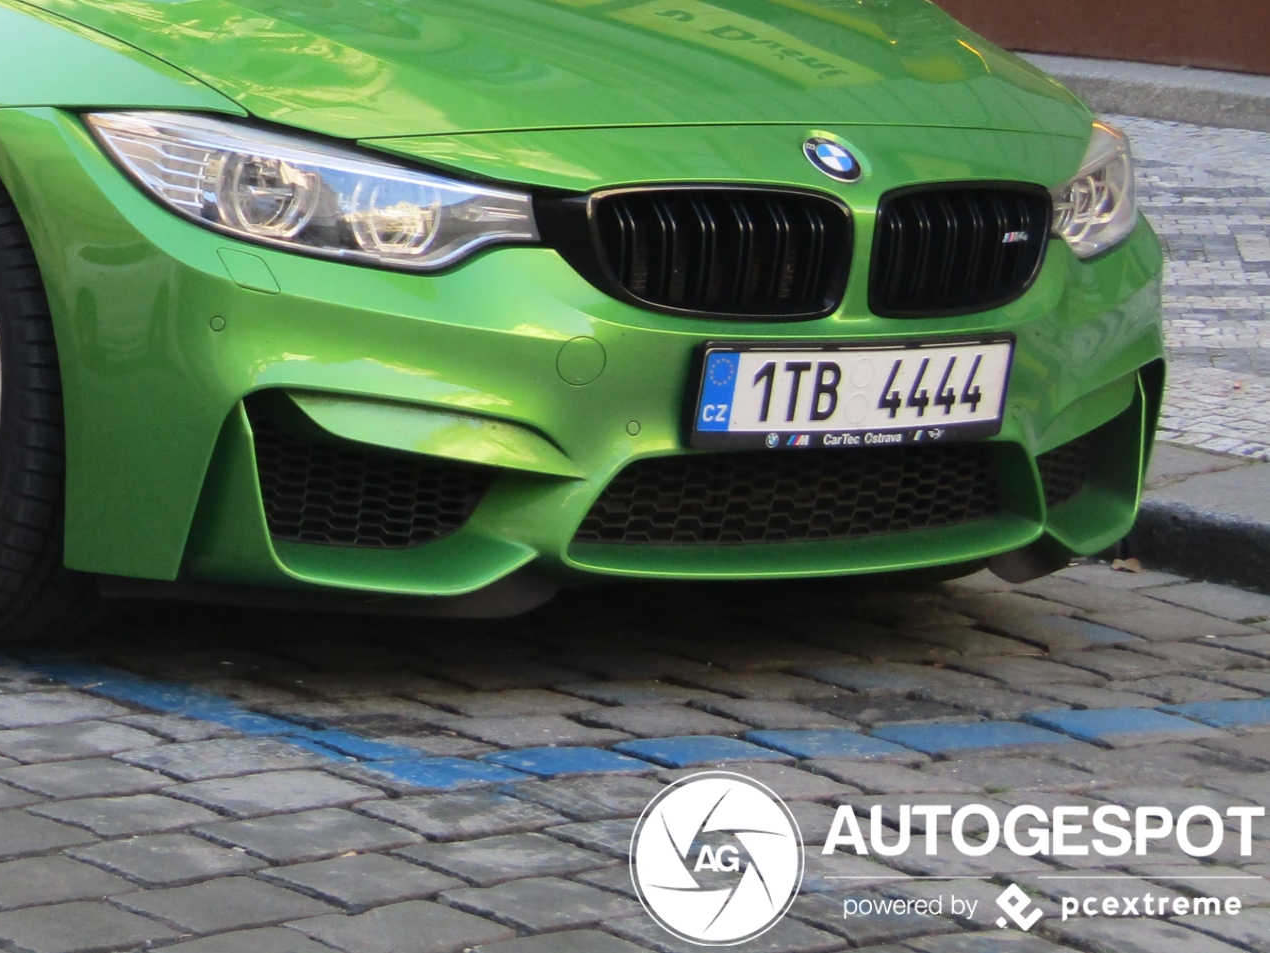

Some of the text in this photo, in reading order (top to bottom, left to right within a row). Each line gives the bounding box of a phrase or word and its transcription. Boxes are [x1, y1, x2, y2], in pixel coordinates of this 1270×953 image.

[752, 354, 983, 422] 1TB 4444
[702, 404, 728, 422] CZ
[823, 433, 860, 445] CarTec
[864, 432, 902, 444] Ostrava
